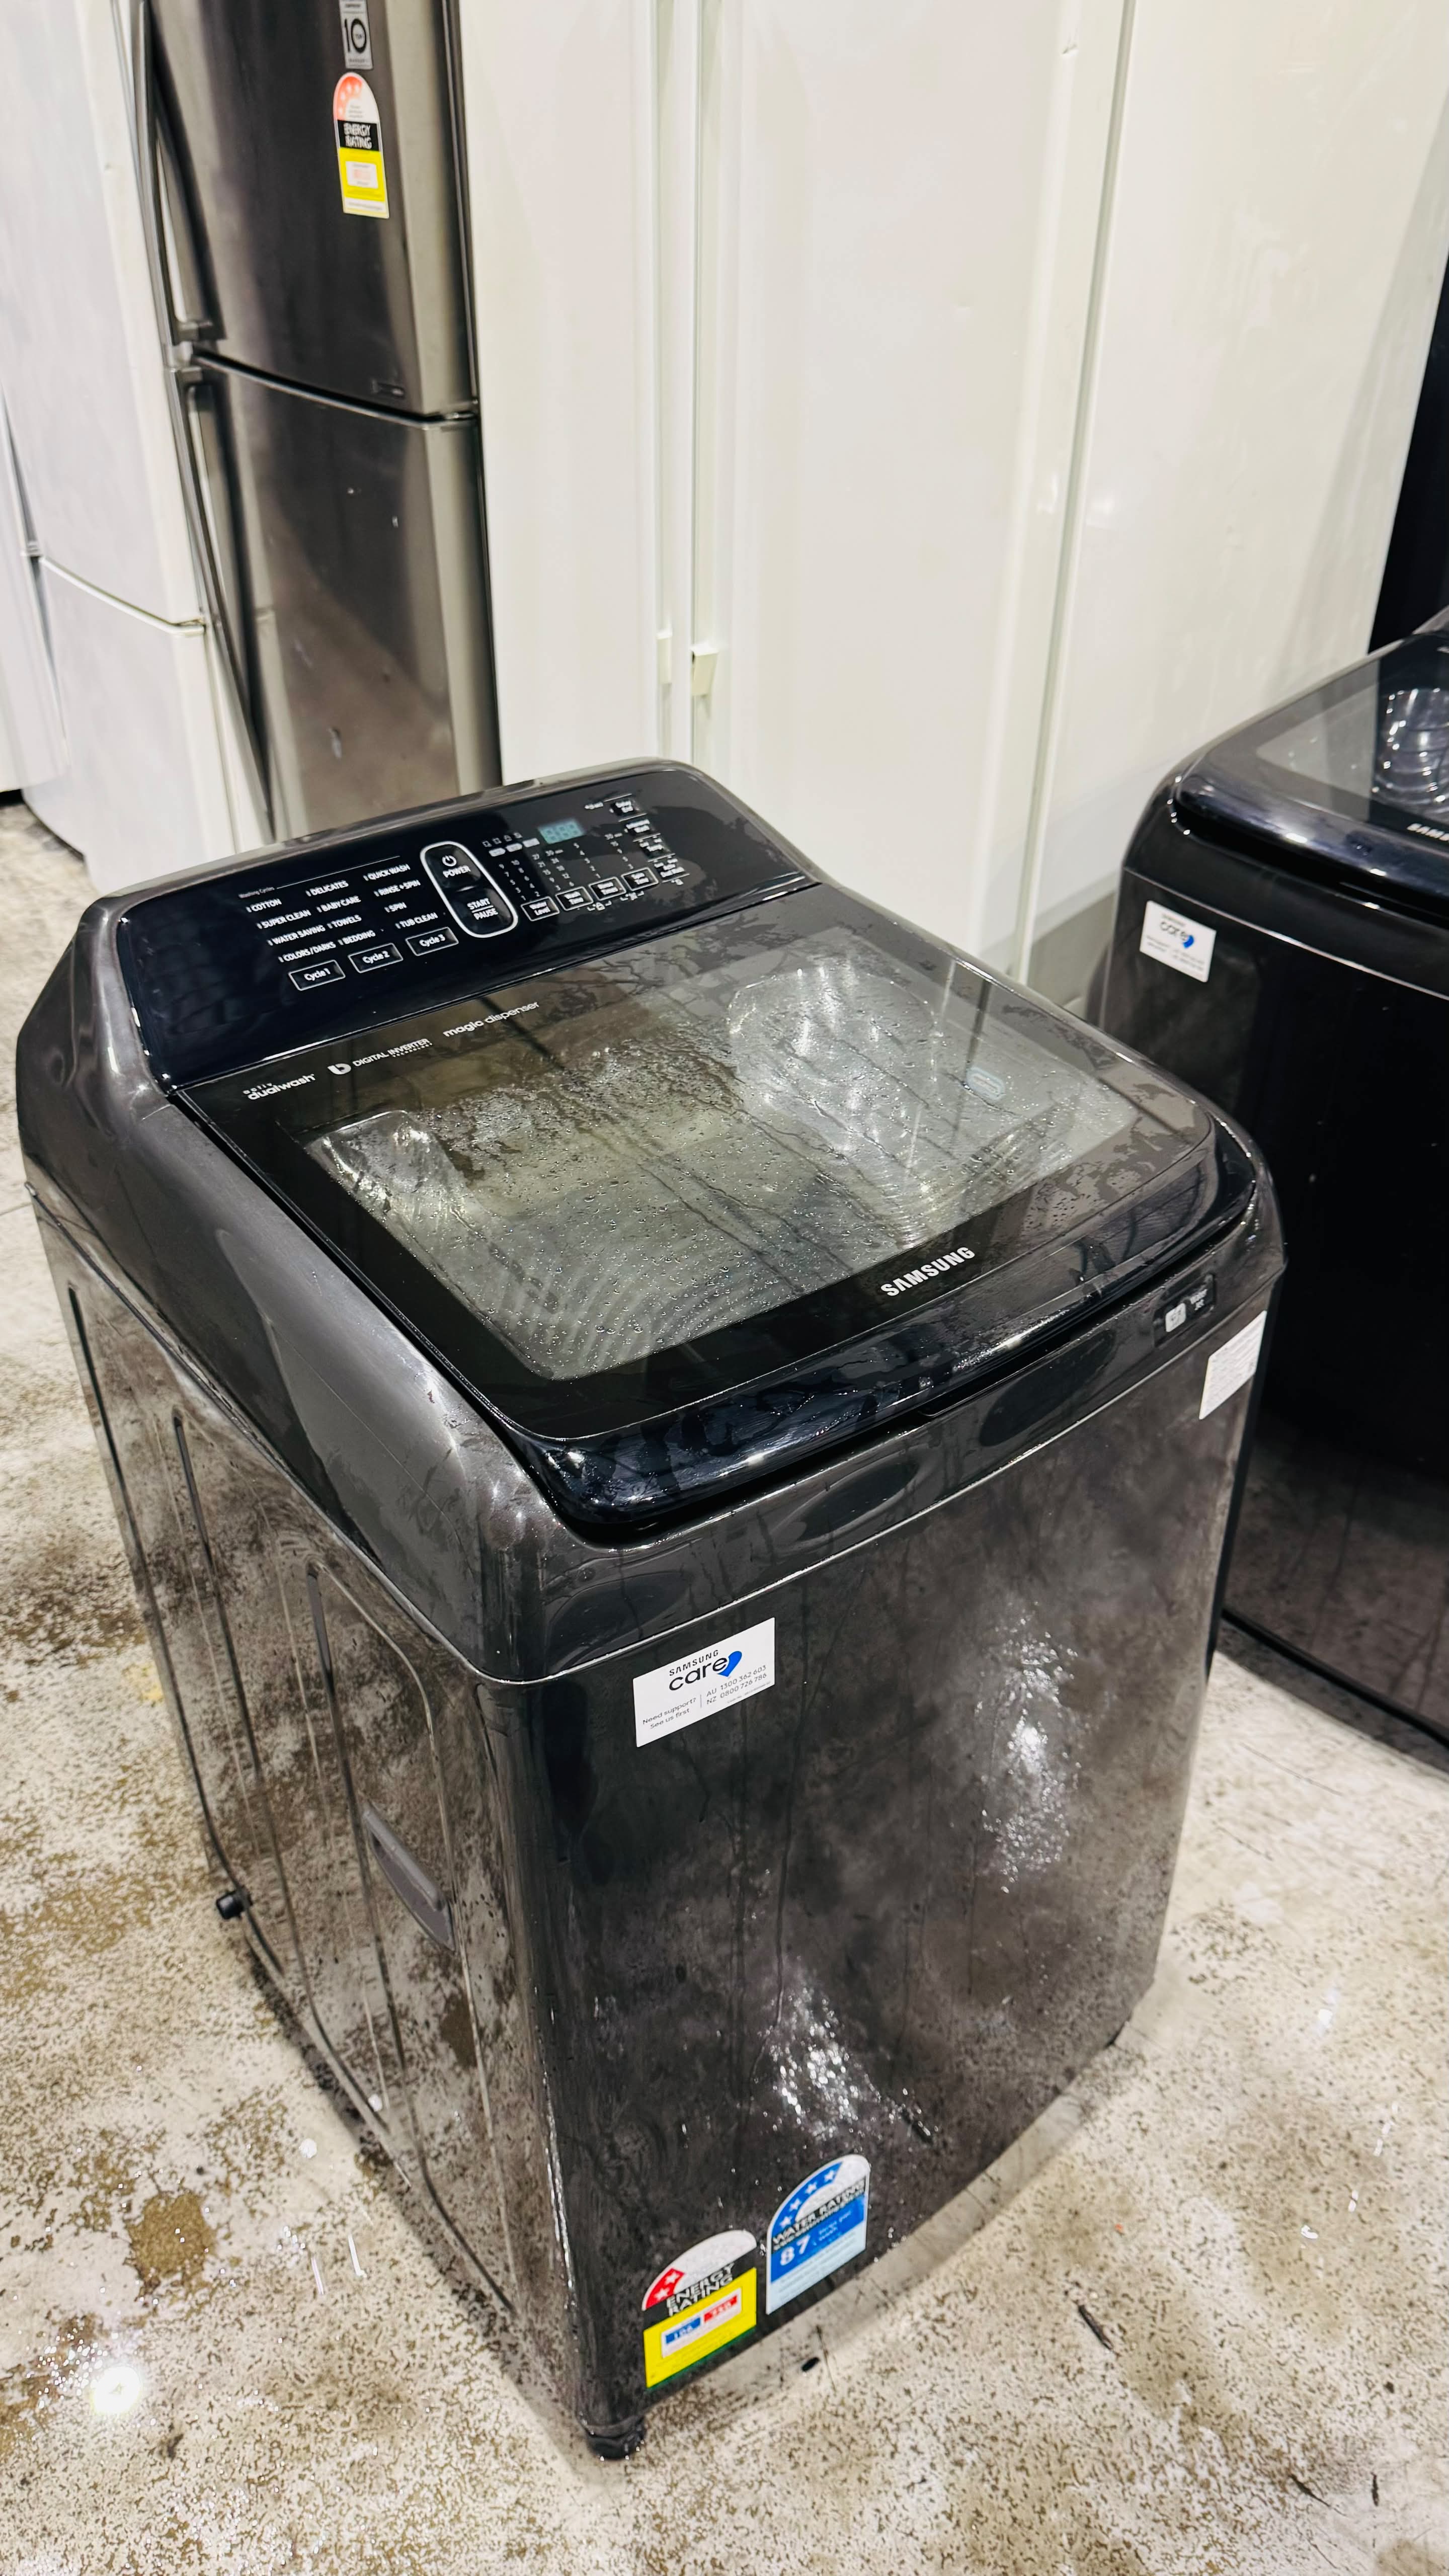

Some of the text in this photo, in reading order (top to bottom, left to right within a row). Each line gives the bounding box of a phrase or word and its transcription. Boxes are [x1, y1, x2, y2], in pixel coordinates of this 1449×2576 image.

[343, 123, 371, 136] ENERGY
[368, 864, 411, 880] QUICK WASH
[443, 865, 471, 878] POWER
[310, 880, 349, 896] DELICATES
[378, 884, 400, 896] RINSE
[403, 880, 421, 889] SPIN
[251, 898, 282, 912] COTTON
[321, 896, 361, 912] BABY CARE
[389, 902, 407, 912] SPIN
[467, 898, 491, 910] START
[261, 909, 311, 928] SUPER CLEAN
[332, 914, 362, 927] TOWELS
[399, 912, 438, 928] TUB CLEAN
[473, 908, 498, 920] PAUSE
[272, 924, 326, 944] WATER SAVING
[342, 930, 376, 944] BEDDING
[419, 936, 440, 947] Cycle
[362, 953, 384, 964] Cycle
[304, 970, 326, 981] Cycle
[443, 1002, 539, 1037] magic dispenser
[353, 1052, 389, 1067] DIGITAL
[387, 1038, 430, 1055] INVERTER
[248, 1075, 315, 1100] dualwash
[880, 1247, 975, 1296] SAMSUNG
[669, 1650, 718, 1676] SAMSUNG
[669, 1658, 728, 1691] care
[706, 1688, 717, 1697] AU
[720, 1679, 737, 1690] 1300
[739, 1672, 751, 1682] 362
[753, 1665, 766, 1675] 603
[706, 1696, 717, 1705] NZ
[720, 1686, 739, 1698] 0800
[741, 1679, 753, 1689] 726
[754, 1673, 767, 1682] 786
[642, 1698, 696, 1725] Need support?
[676, 1708, 690, 1719] first
[773, 2213, 816, 2243] WATER
[780, 2234, 810, 2266] 87
[667, 2263, 734, 2308] ENERGY
[668, 2275, 733, 2316] RATING
